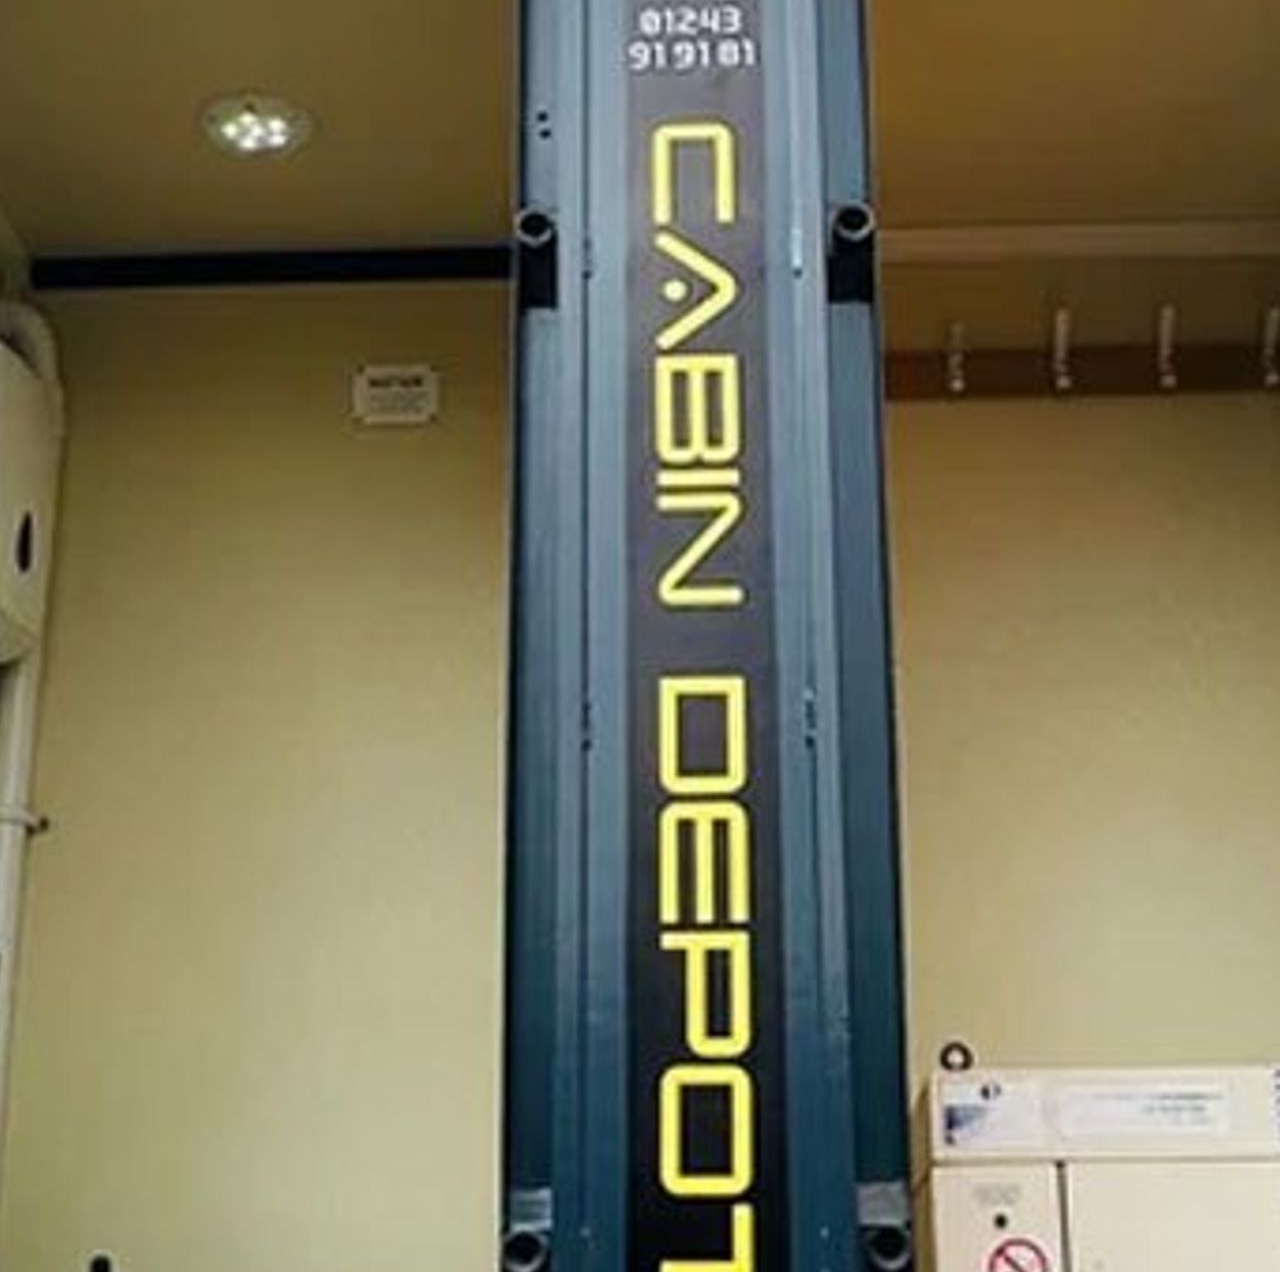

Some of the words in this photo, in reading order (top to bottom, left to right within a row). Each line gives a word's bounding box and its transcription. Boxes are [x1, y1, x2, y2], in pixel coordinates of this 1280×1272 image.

[639, 7, 742, 35] 01243
[628, 40, 756, 70] 919181
[652, 123, 744, 606] CABIN
